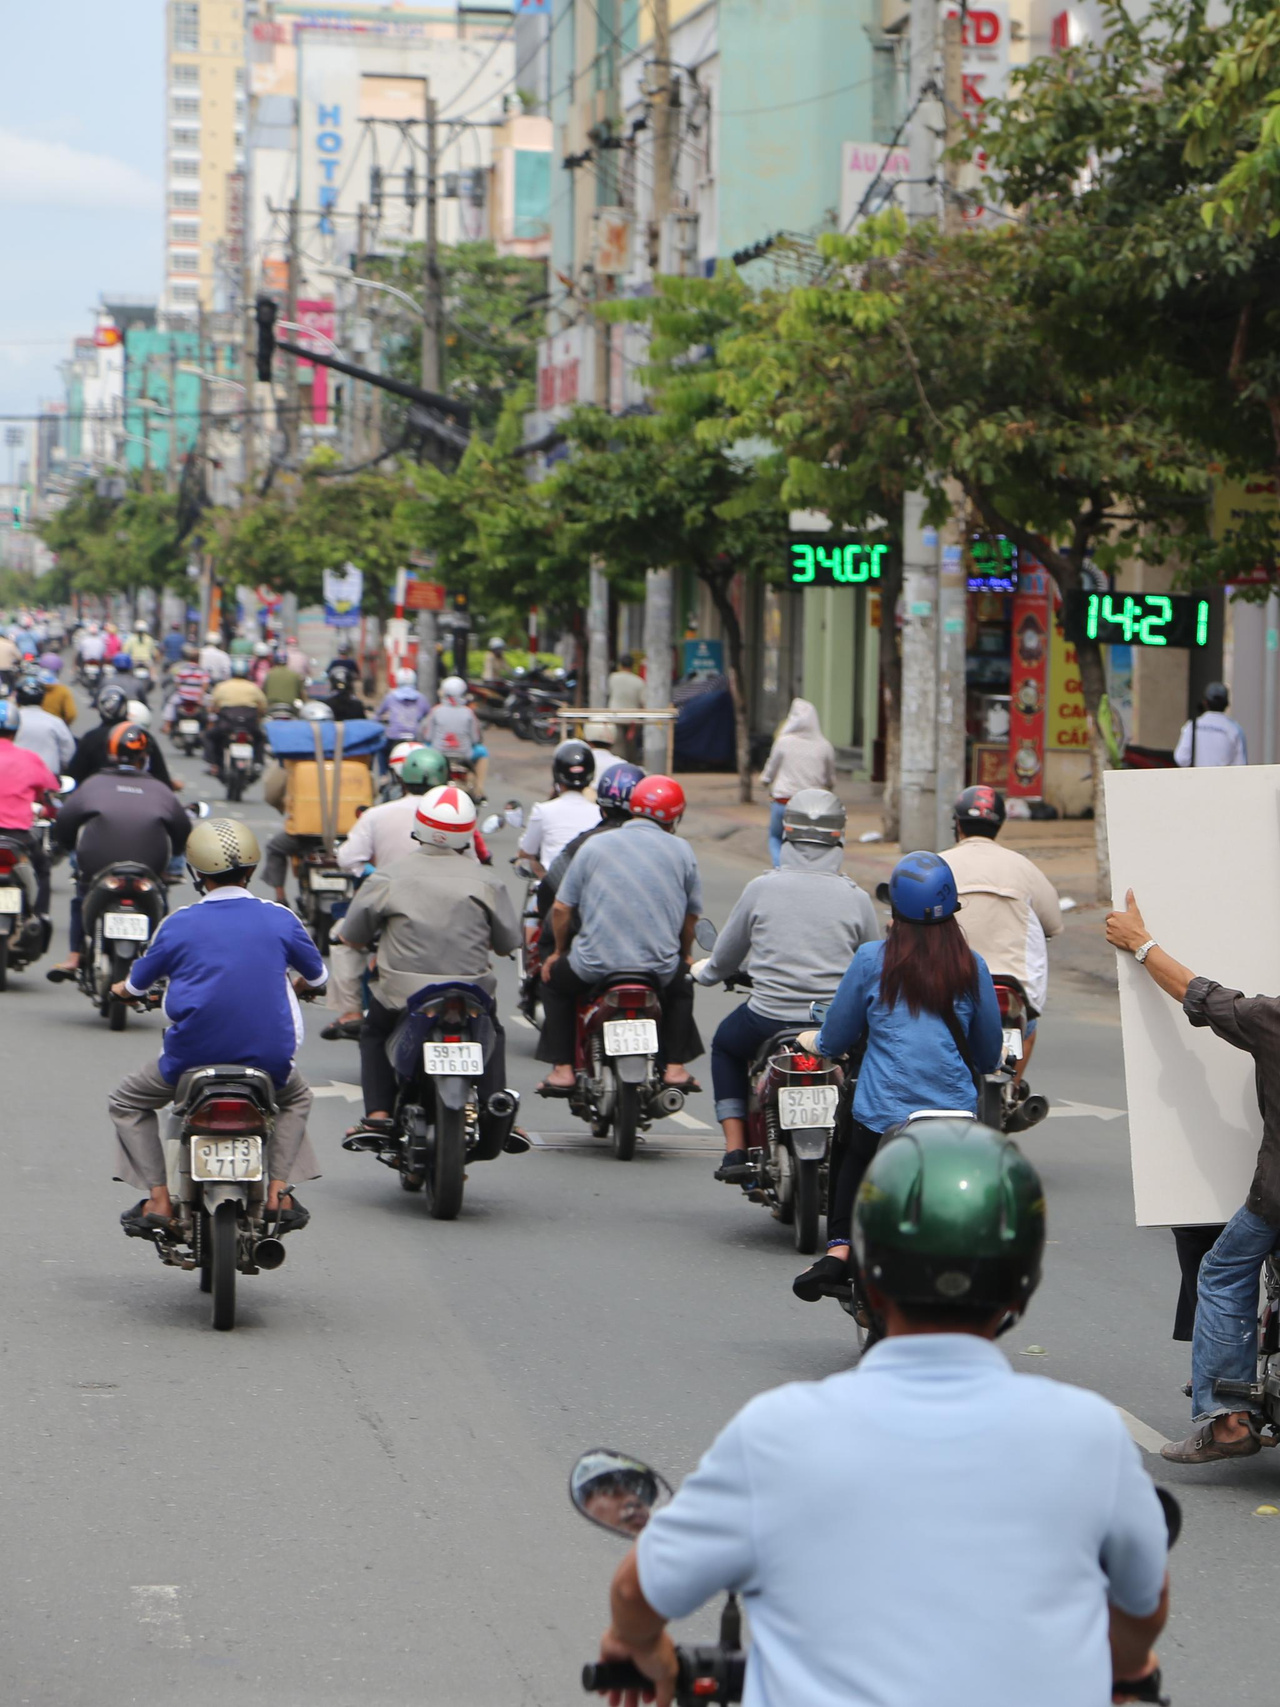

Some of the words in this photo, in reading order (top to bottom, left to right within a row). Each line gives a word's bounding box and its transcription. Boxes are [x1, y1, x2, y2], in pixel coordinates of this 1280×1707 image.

[316, 104, 342, 235] HOTEL
[1087, 594, 1209, 646] 14:21
[428, 1060, 479, 1073] 316.09
[788, 1089, 827, 1107] 52-U1
[789, 1107, 829, 1125] 2067
